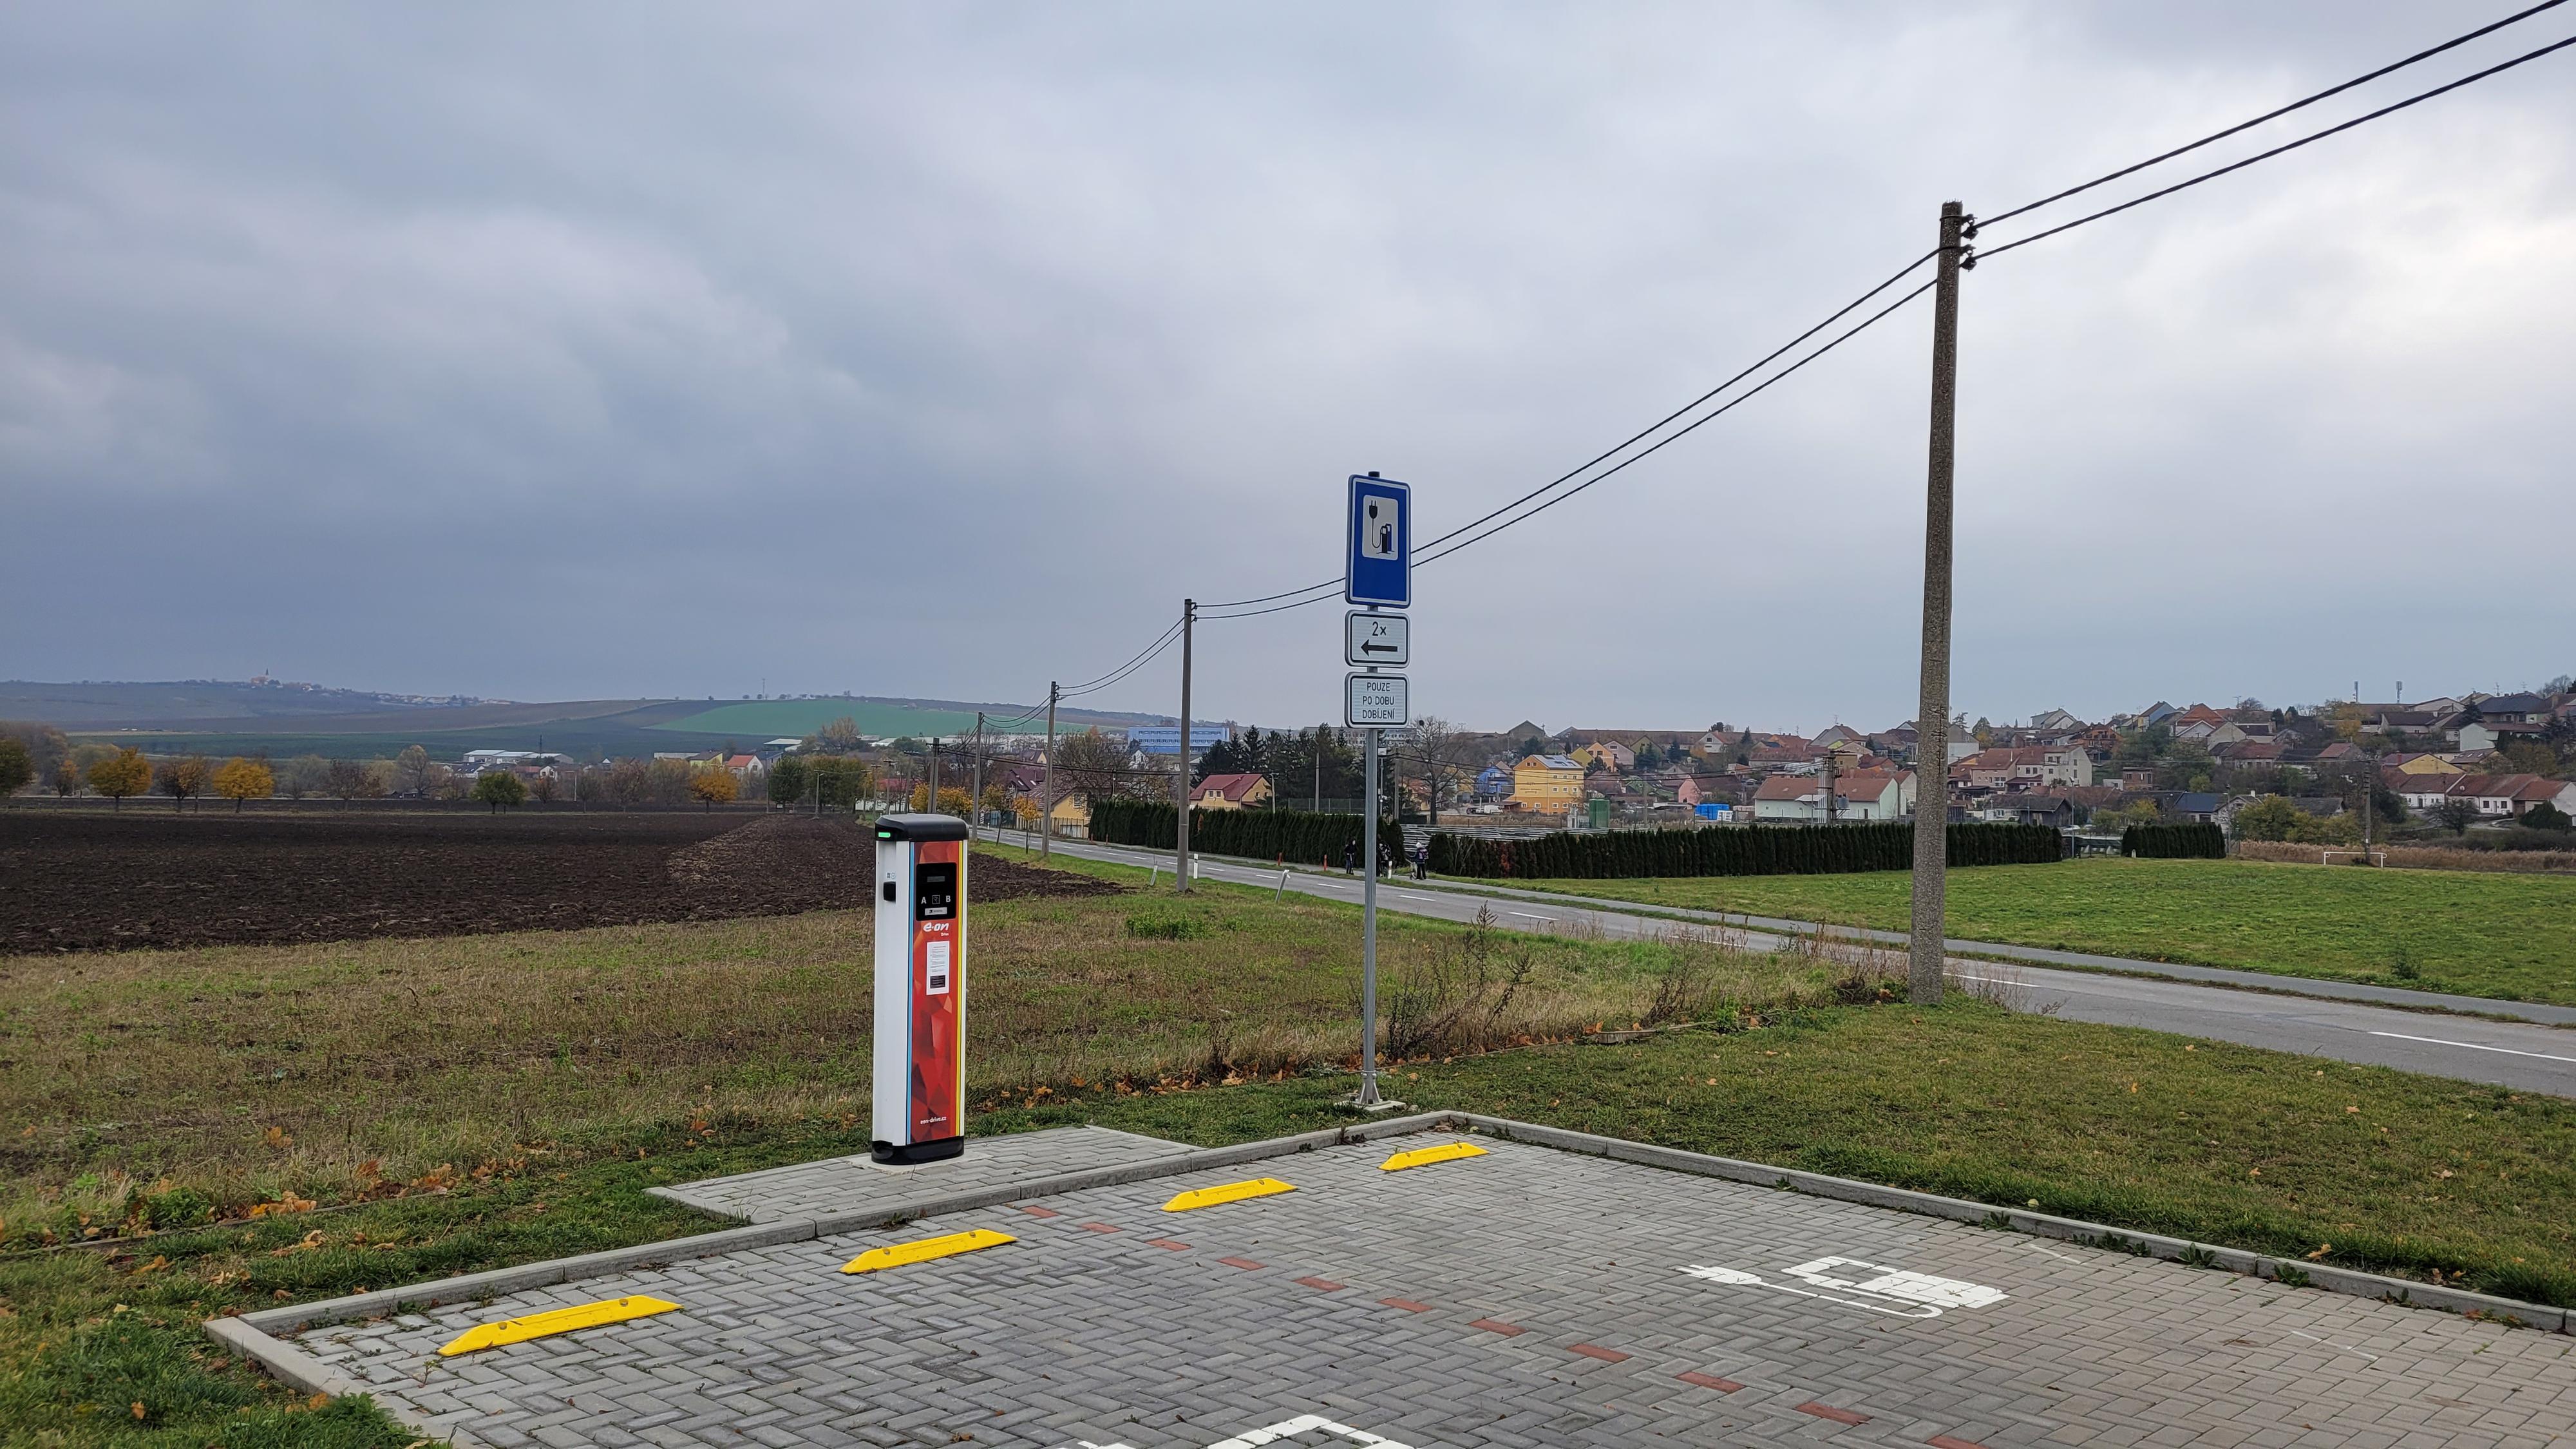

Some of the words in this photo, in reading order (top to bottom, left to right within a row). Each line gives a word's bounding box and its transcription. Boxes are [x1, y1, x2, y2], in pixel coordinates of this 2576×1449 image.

[1372, 621, 1387, 636] 2x
[1367, 681, 1391, 692] POUZE
[1362, 696, 1372, 705] PO
[1375, 696, 1395, 706] DOBU
[1362, 707, 1396, 719] DOBÍJENÍ
[921, 896, 927, 905] A
